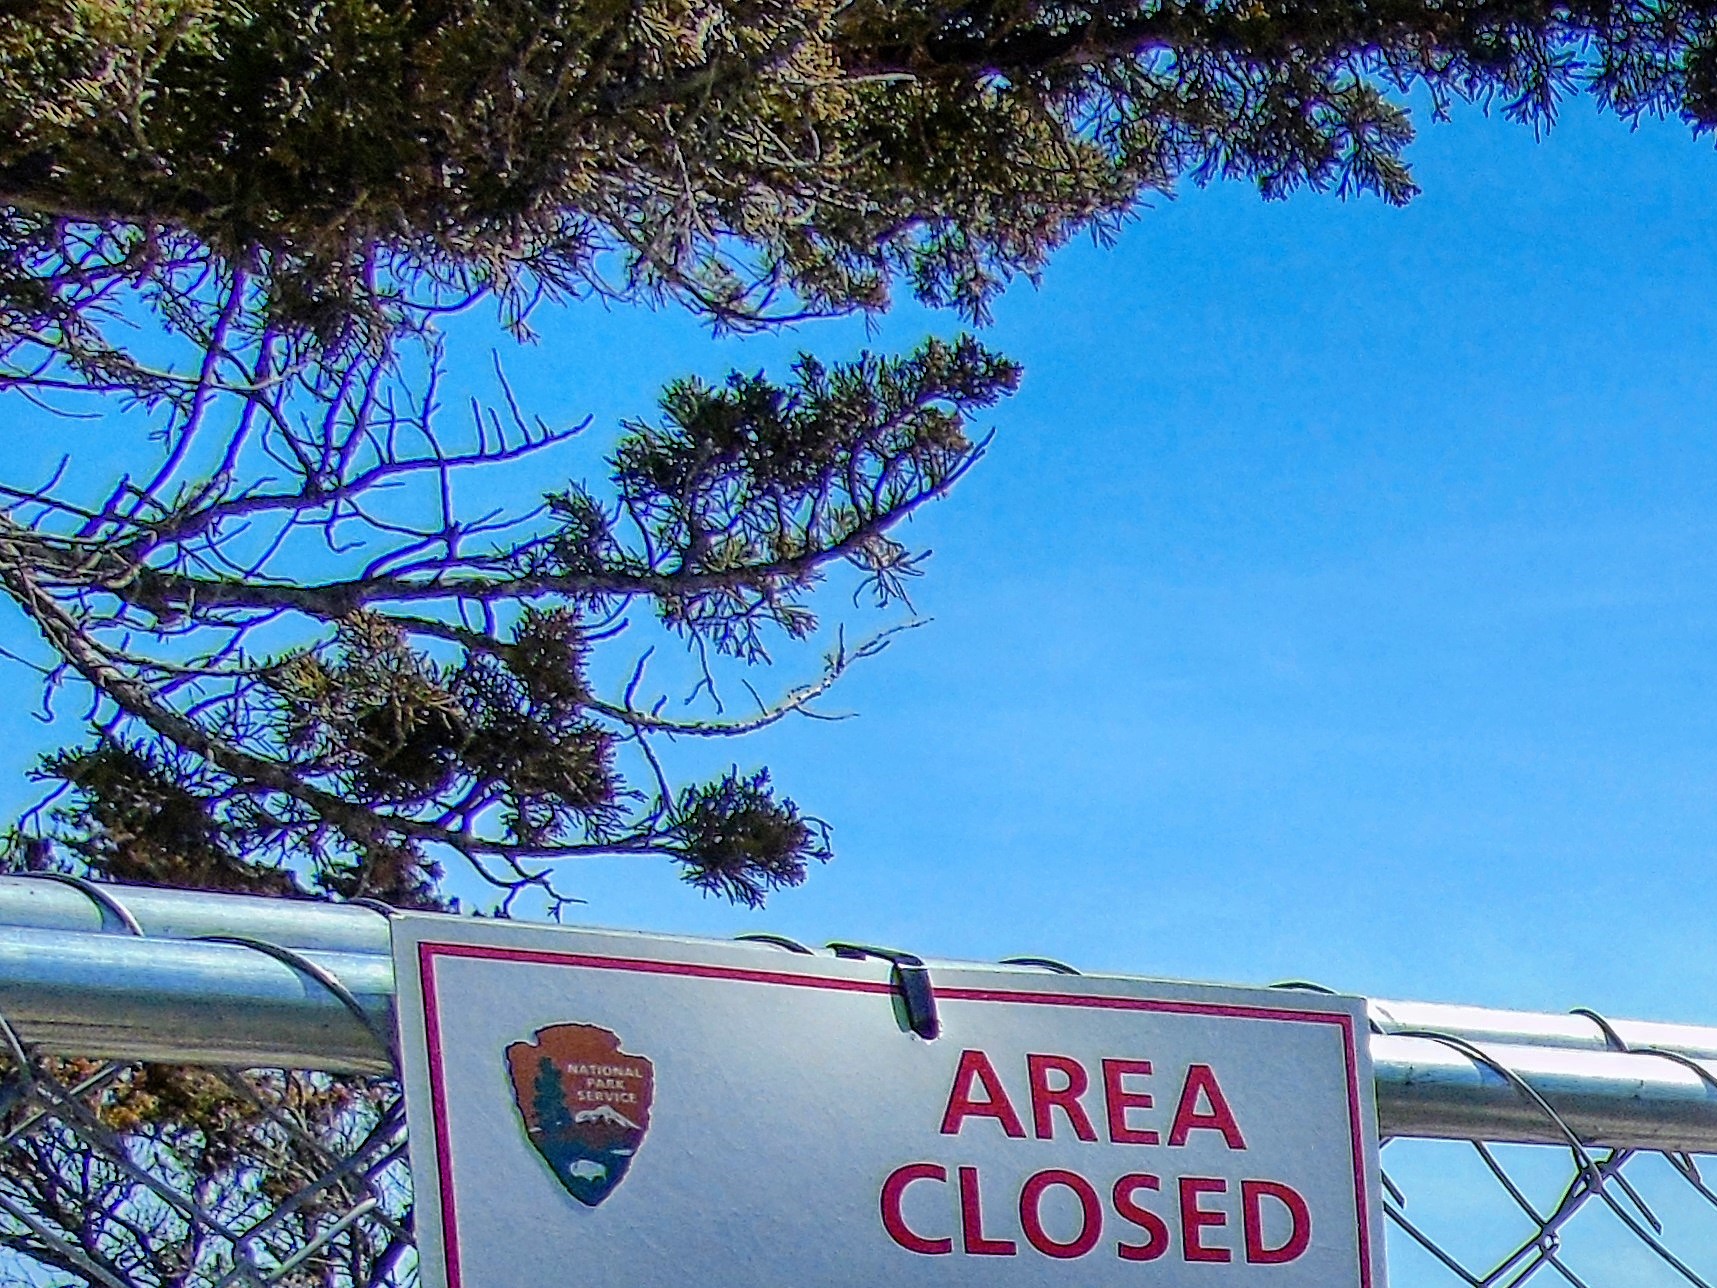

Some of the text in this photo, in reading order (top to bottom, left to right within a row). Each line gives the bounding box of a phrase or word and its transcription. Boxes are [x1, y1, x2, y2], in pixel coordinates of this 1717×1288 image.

[568, 1063, 643, 1078] NATIONAL
[587, 1077, 625, 1089] PARK
[577, 1090, 637, 1103] SERVICE
[940, 1049, 1247, 1150] AREA
[880, 1163, 1312, 1264] CLOSED
